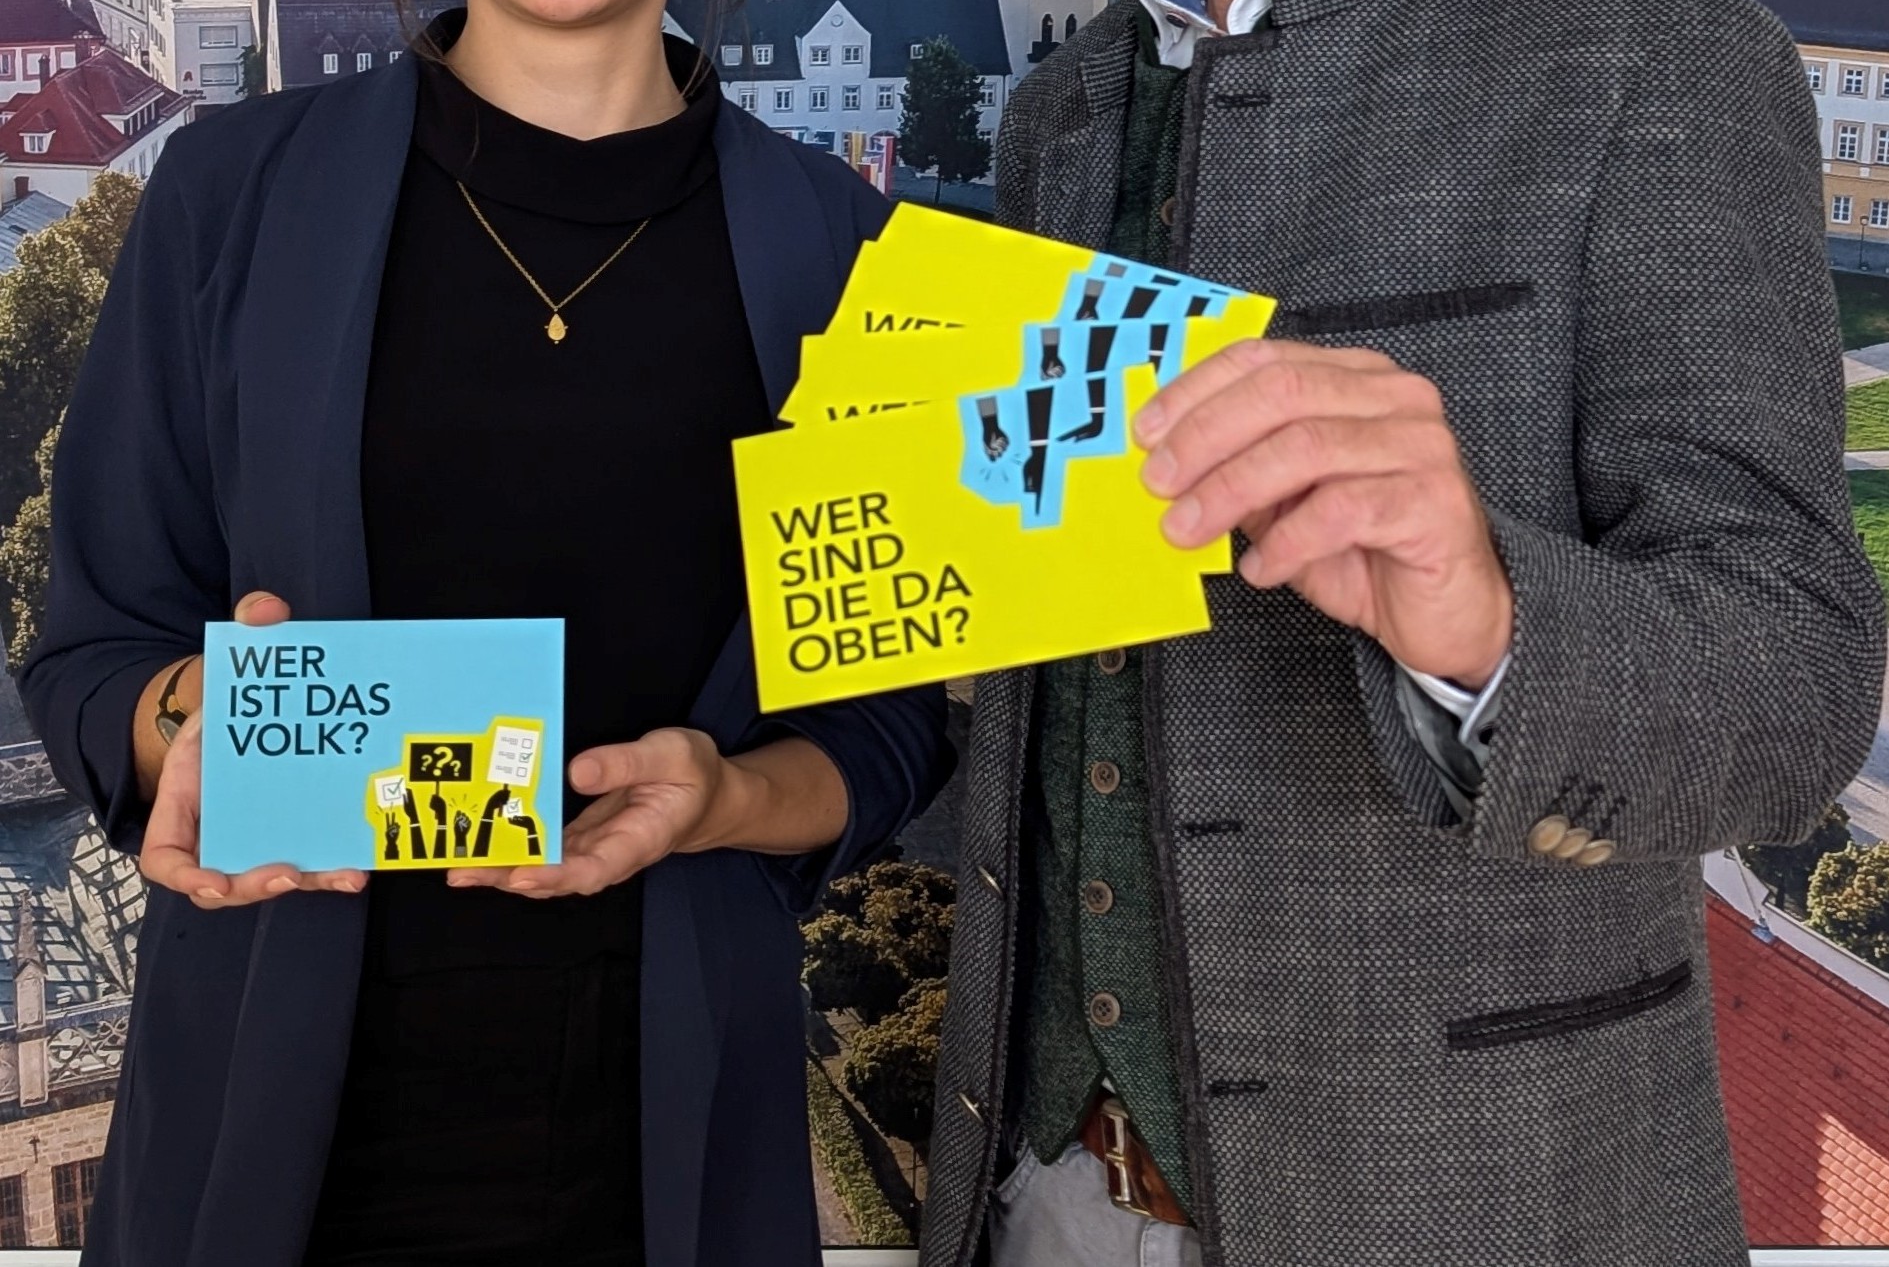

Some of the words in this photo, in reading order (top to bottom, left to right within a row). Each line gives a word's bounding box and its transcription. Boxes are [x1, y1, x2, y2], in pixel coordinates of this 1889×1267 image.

[770, 491, 891, 545] WER
[779, 532, 904, 588] SIND
[784, 581, 870, 630] DIE
[892, 564, 972, 610] DA
[228, 645, 326, 679] WER
[789, 606, 970, 673] OBEN?
[229, 684, 290, 718] IST
[305, 682, 391, 716] DAS
[226, 721, 370, 757] VOLK?
